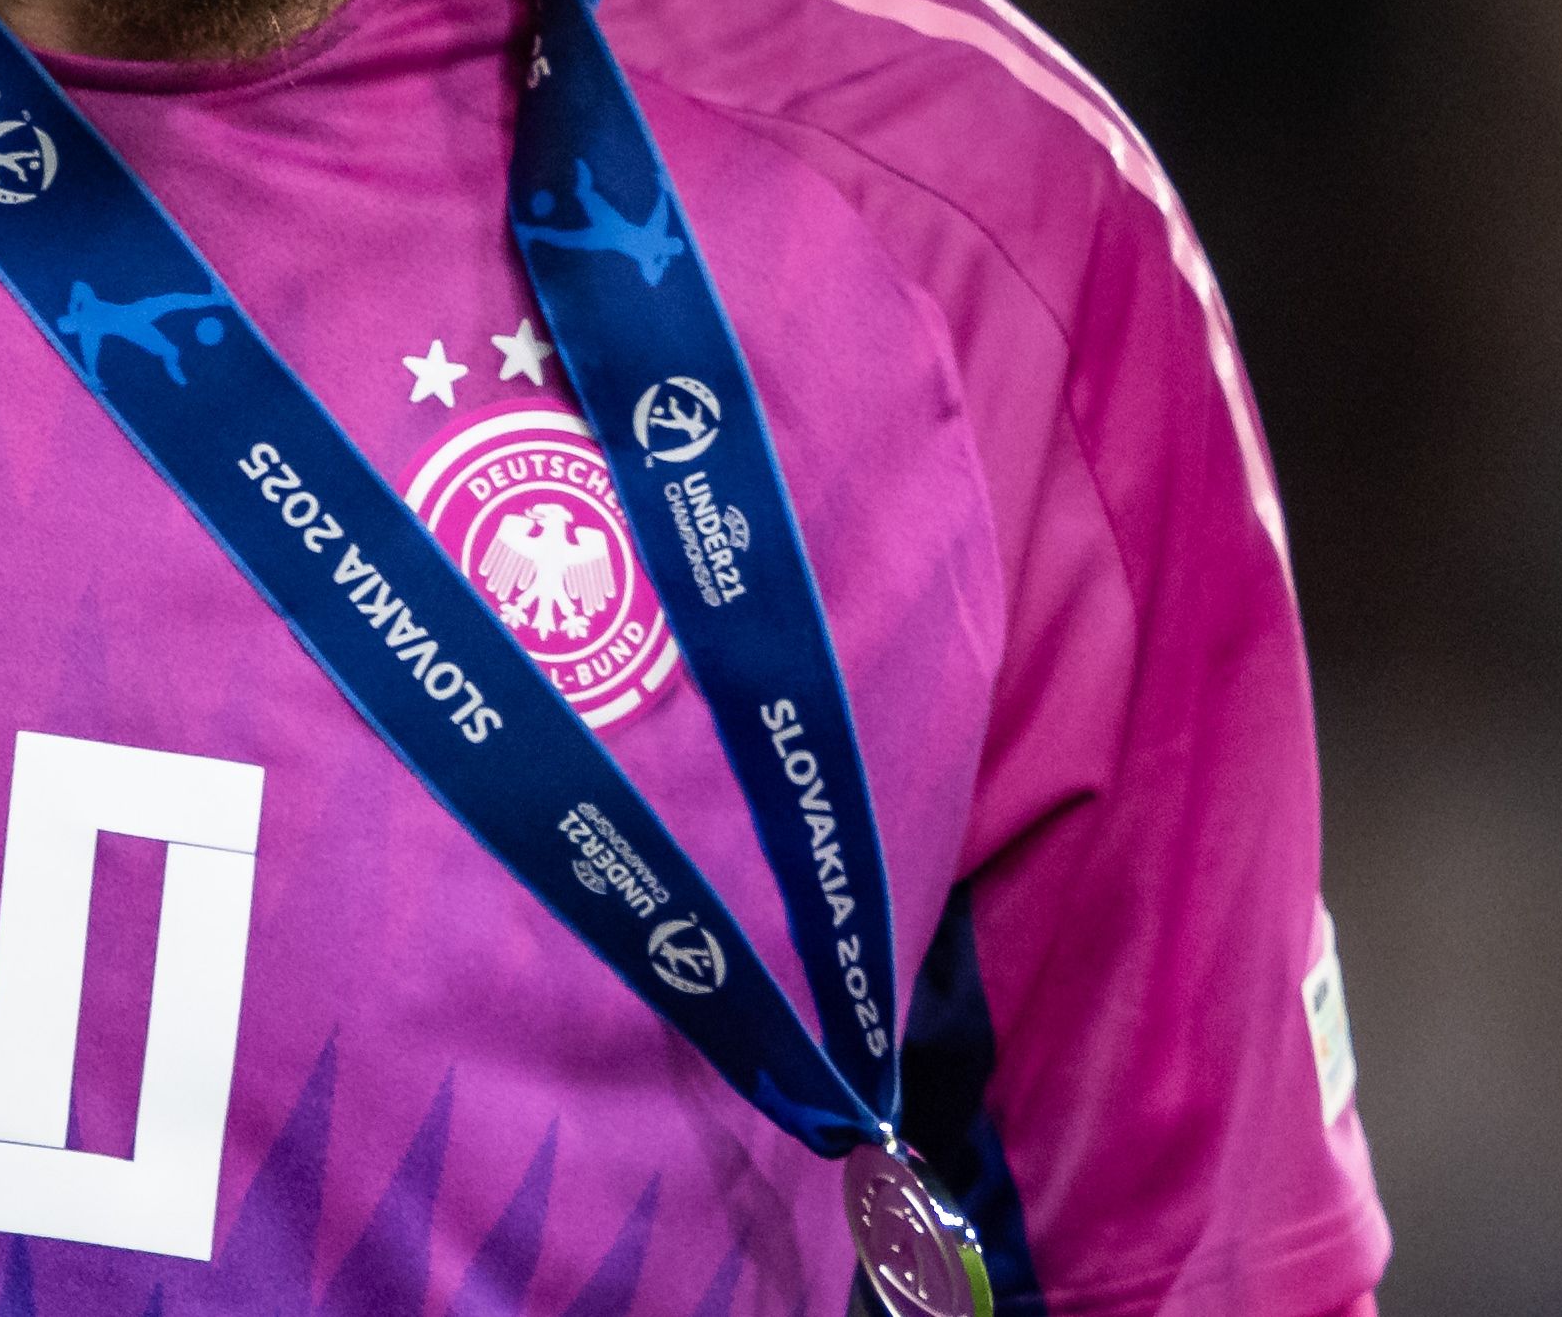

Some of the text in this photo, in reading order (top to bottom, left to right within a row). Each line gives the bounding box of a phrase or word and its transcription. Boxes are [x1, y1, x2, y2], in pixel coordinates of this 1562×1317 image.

[467, 454, 619, 511] DEUTSCHE
[683, 471, 747, 603] UNDER21
[238, 442, 503, 744] SLOVAKIA 2025
[551, 621, 645, 689] L-BUND
[557, 809, 656, 919] UNDER21
[759, 697, 890, 1058] SLOVAKIA 2025
